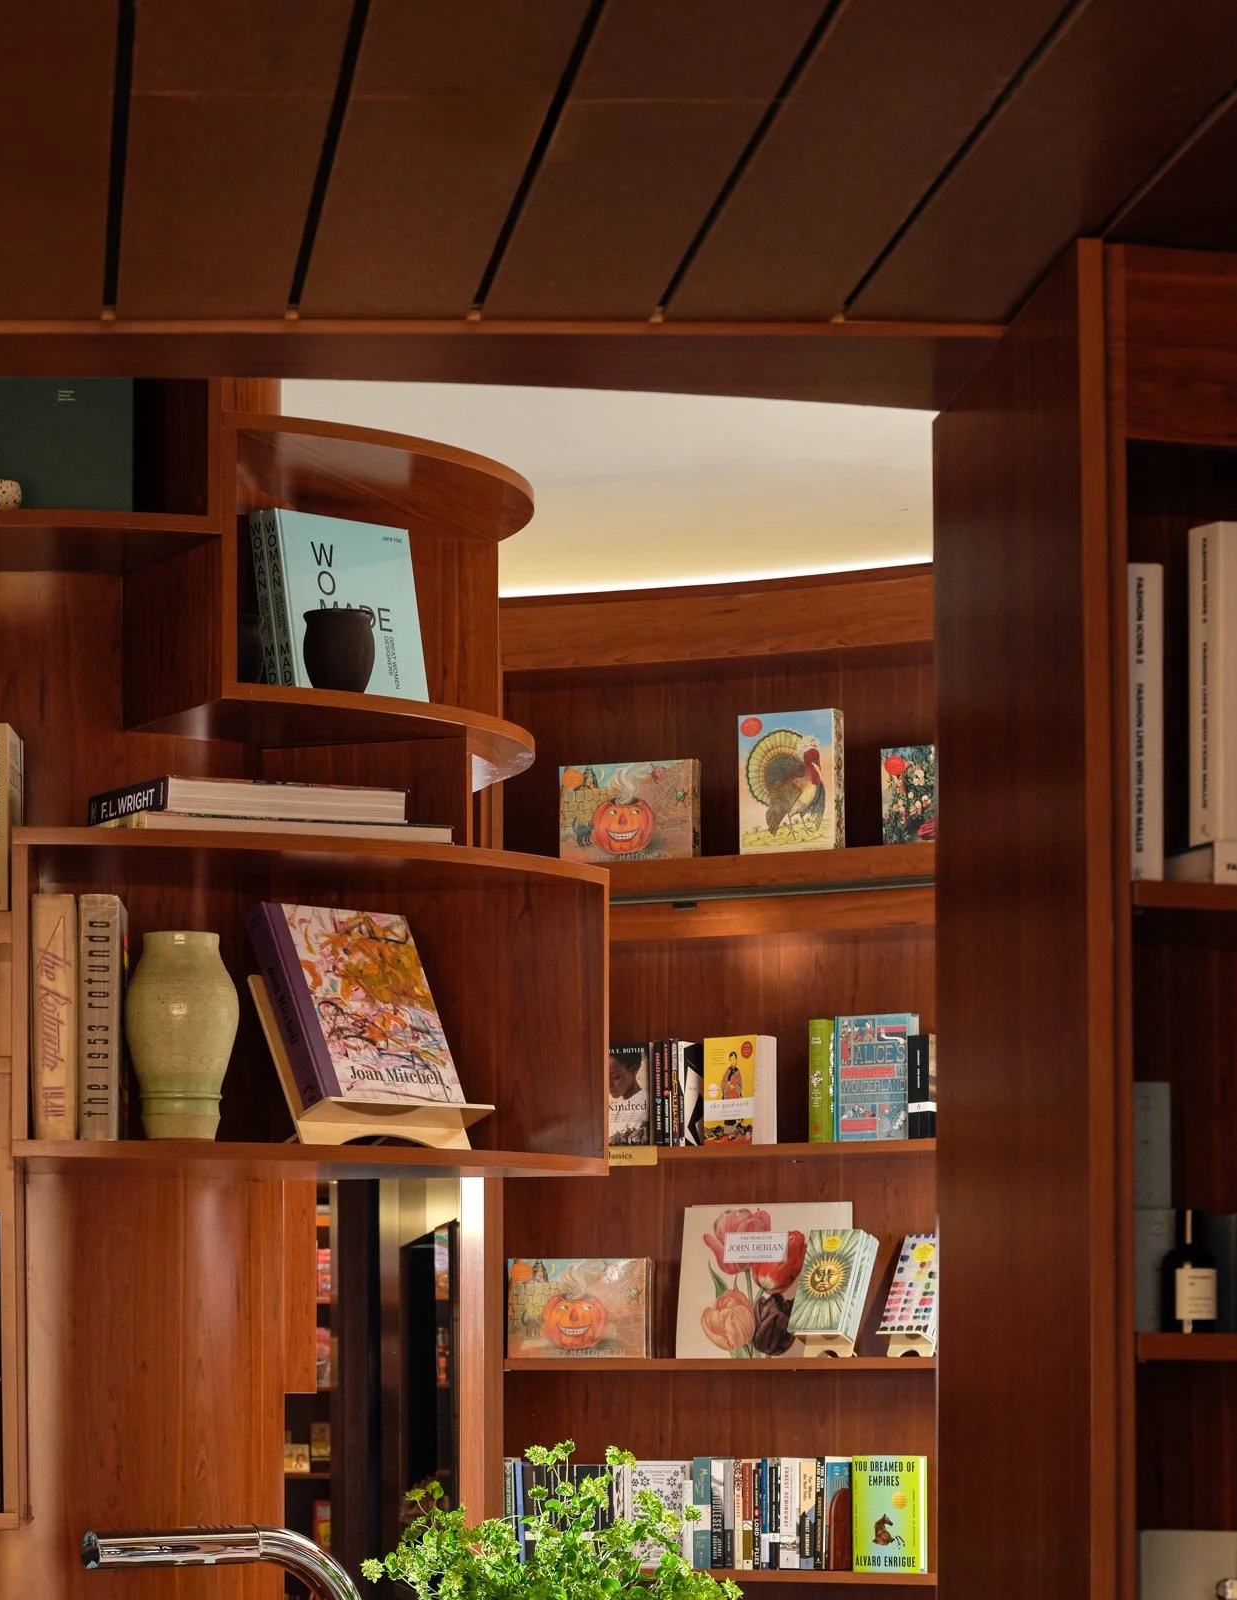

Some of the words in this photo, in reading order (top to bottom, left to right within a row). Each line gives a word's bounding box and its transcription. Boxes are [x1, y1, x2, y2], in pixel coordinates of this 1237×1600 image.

[350, 1065, 384, 1084] Joan
[387, 1068, 444, 1086] Mitchell
[728, 1242, 749, 1253] JOHN
[752, 1242, 784, 1252] DERIAN
[855, 1461, 868, 1472] YOU
[869, 1461, 904, 1473] DREAMED
[906, 1462, 915, 1472] OF
[869, 1475, 900, 1486] EMPIRES
[884, 1556, 916, 1567] ENRIGUE
